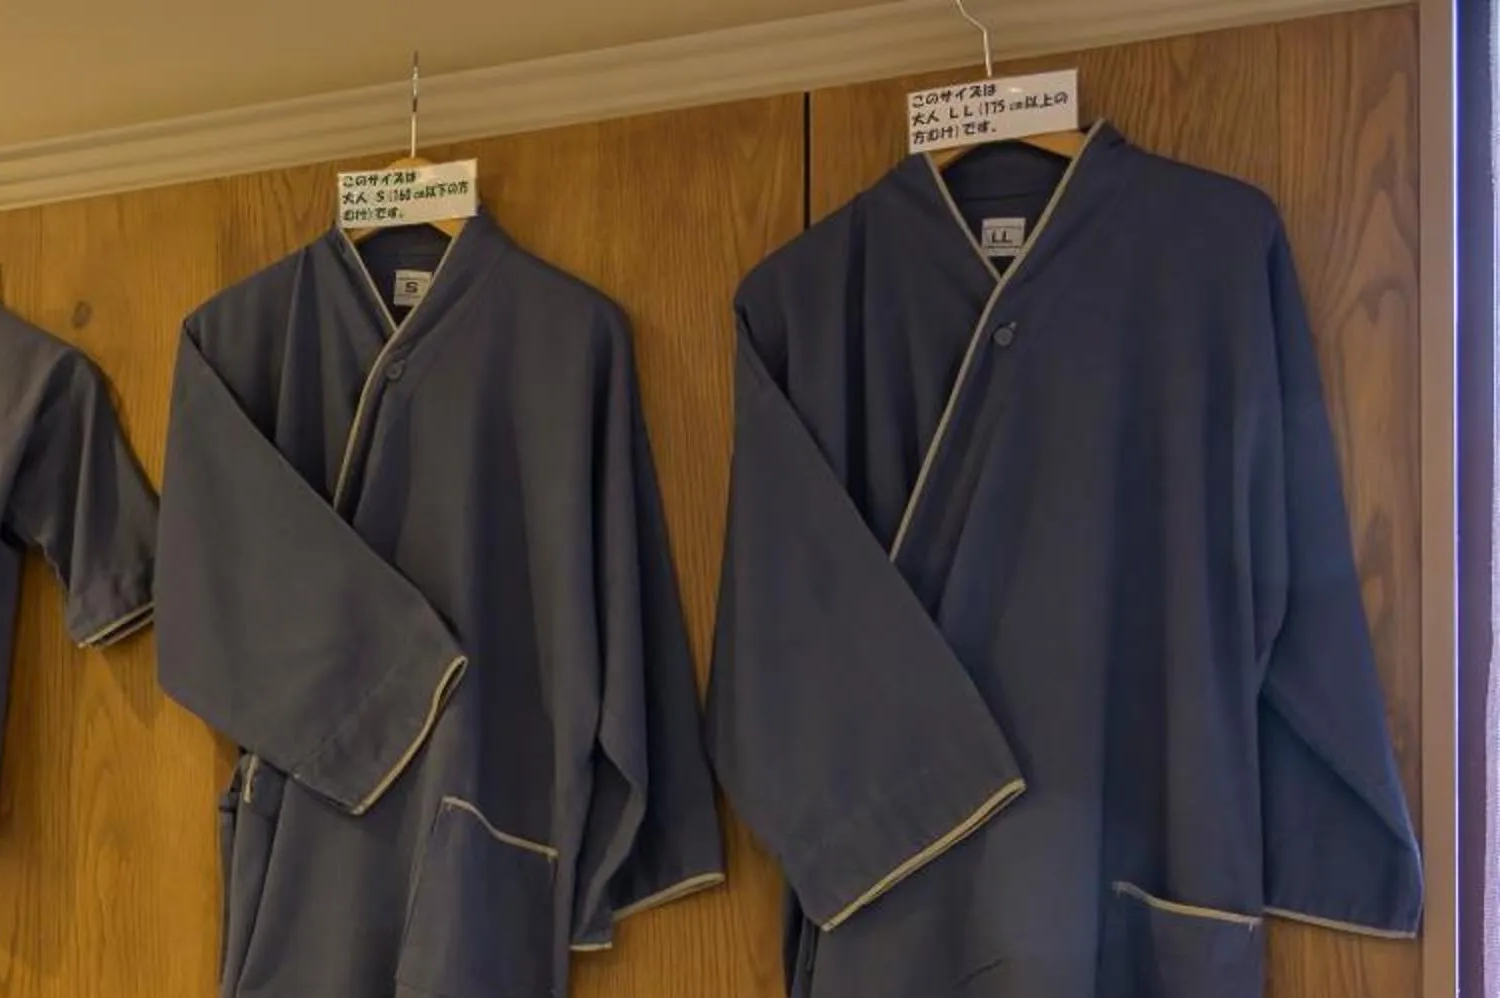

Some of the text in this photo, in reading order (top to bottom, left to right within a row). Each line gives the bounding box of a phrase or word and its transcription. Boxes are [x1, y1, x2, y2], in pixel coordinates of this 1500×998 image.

[912, 84, 996, 108] このサイズは
[342, 171, 416, 187] このサイズは
[991, 229, 1013, 243] LL
[405, 281, 418, 293] S
